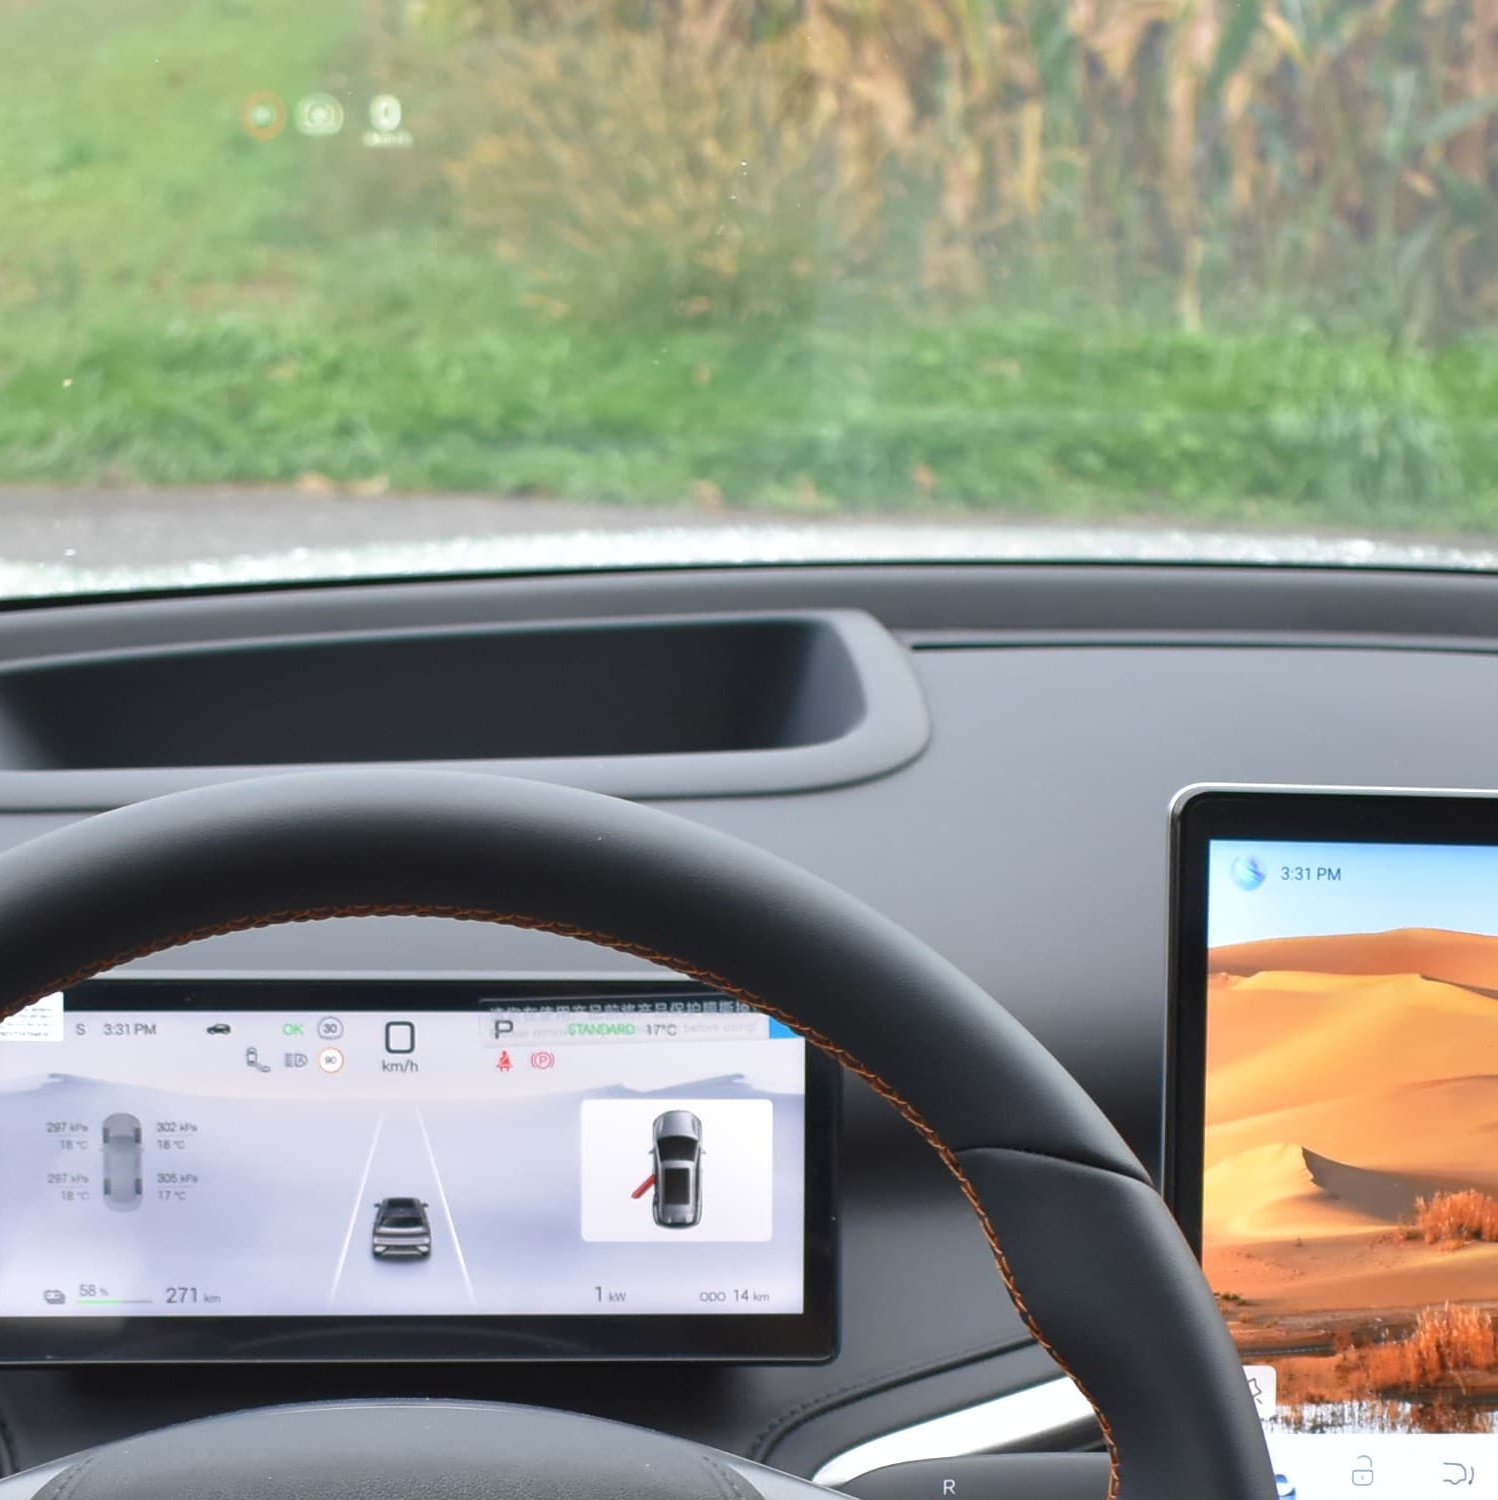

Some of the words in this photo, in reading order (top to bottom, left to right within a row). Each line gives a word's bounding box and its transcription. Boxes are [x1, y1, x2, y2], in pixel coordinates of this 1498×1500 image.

[1281, 866, 1311, 881] 3:31
[1317, 867, 1342, 881] PM
[76, 1023, 86, 1035] S
[103, 1023, 131, 1036] 3:31
[134, 1023, 157, 1036] PM
[283, 1023, 304, 1036] OK
[323, 1023, 338, 1034] 30
[494, 1019, 514, 1039] P
[567, 1023, 635, 1036] STANDARD
[382, 1059, 419, 1073] km/h
[79, 1284, 97, 1297] 58
[166, 1287, 198, 1304] 271
[204, 1293, 222, 1304] km
[594, 1286, 602, 1302] 1
[608, 1291, 627, 1302] kW
[699, 1291, 726, 1302] ODO
[733, 1289, 749, 1302] 14
[753, 1291, 770, 1302] km
[943, 1479, 956, 1494] R
